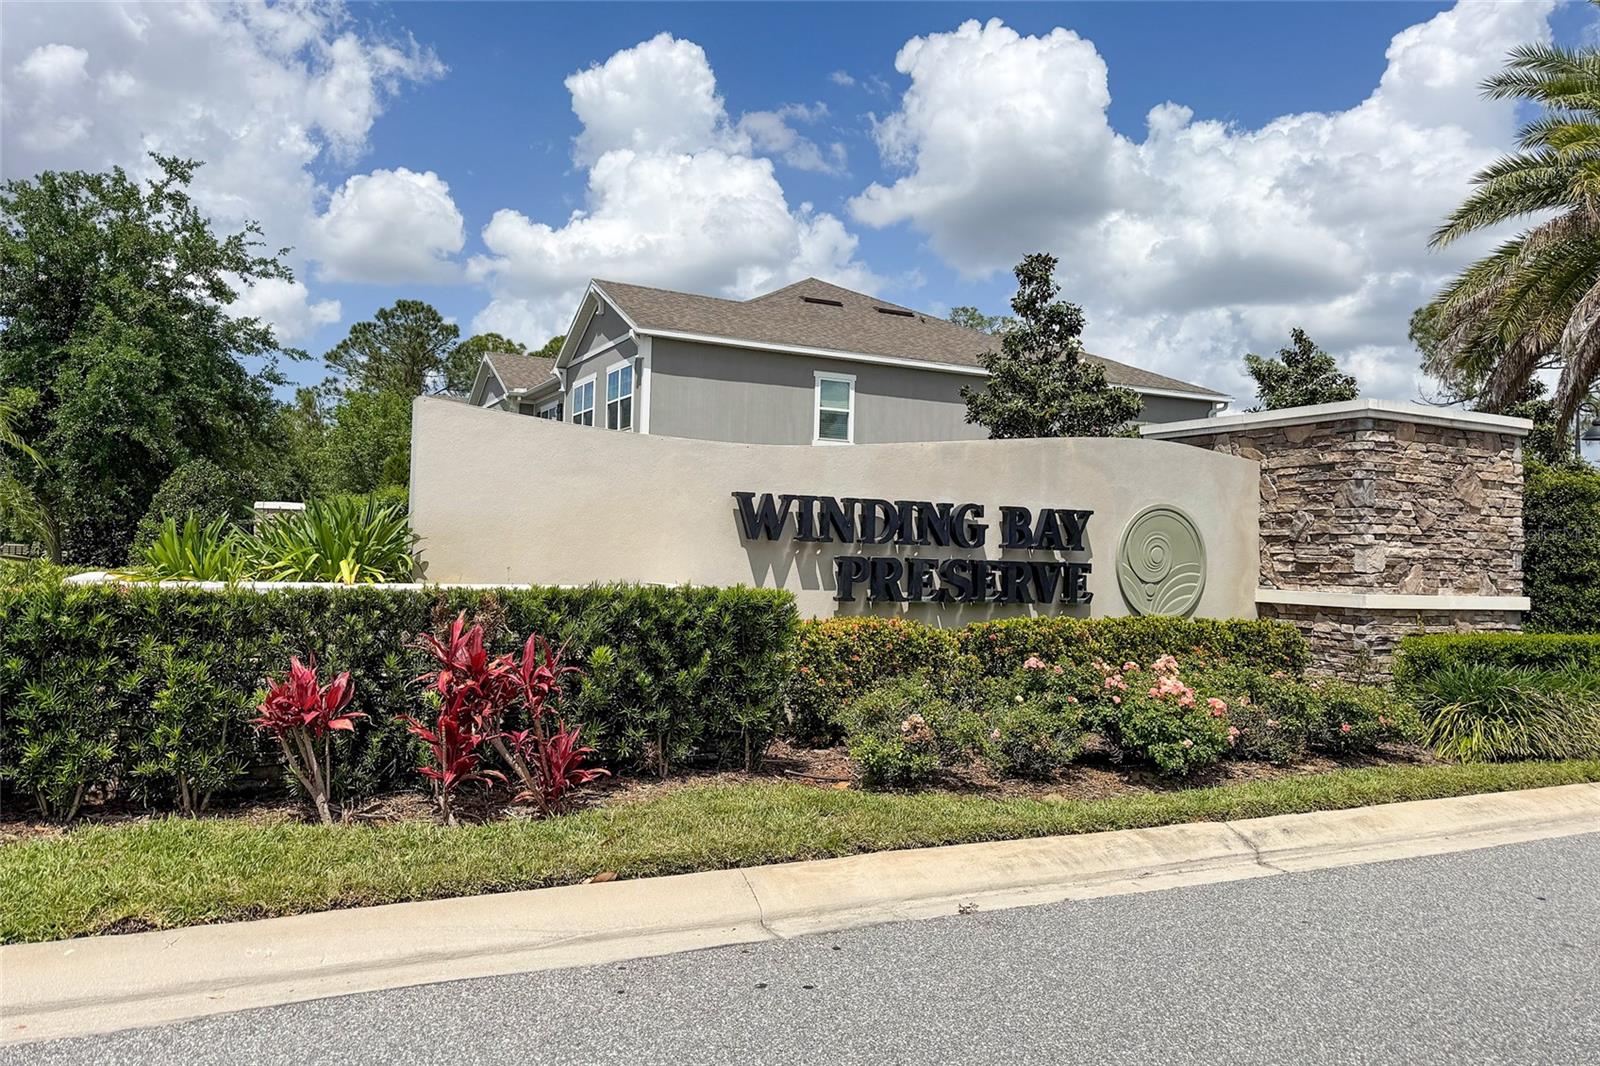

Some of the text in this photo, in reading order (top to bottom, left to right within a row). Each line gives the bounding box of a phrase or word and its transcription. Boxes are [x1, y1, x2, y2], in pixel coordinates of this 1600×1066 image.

[732, 491, 1094, 551] WINDING BAY
[833, 556, 1093, 605] PRESERVE
